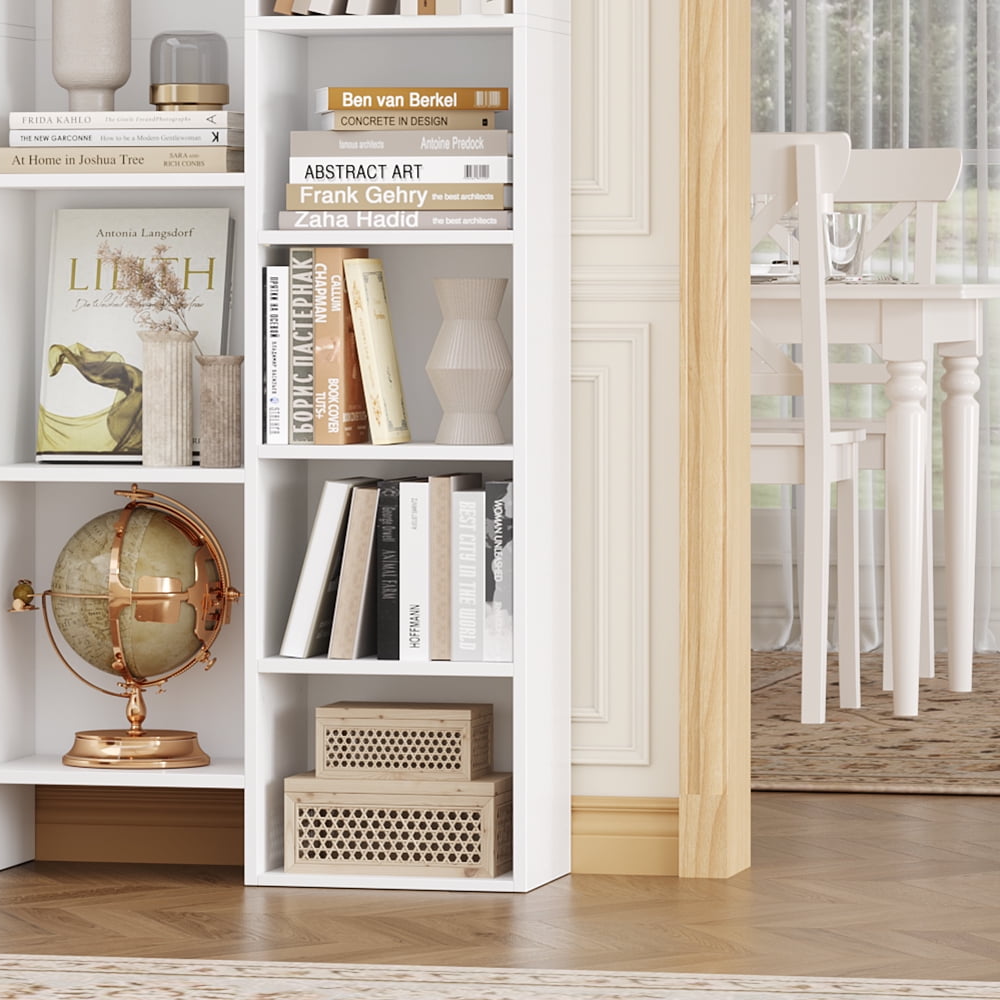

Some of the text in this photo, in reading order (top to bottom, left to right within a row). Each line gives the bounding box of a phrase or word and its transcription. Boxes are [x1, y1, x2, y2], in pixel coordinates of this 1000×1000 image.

[342, 92, 457, 107] Ben van Berkel
[22, 116, 92, 125] FRIDA KAHLO
[340, 116, 448, 126] CONCRETE IN DESIGN
[420, 136, 485, 150] Antoine Predock
[11, 154, 145, 167] At Home in Joshua Tree
[304, 164, 423, 179] ABSTRACT ART
[300, 186, 428, 207] Frank Gehry
[431, 193, 494, 201] the best architects
[294, 211, 419, 228] Zaha Hadid
[432, 217, 498, 225] the best architects
[96, 228, 195, 240] Antonia Langsdorf
[315, 263, 327, 323] CHAPMAN
[330, 274, 341, 312] CALLUM
[292, 251, 315, 434] БОРИС ПАСТЕРНАК
[315, 392, 326, 419] TUTS+
[328, 378, 339, 433] BOOK COVER
[493, 500, 504, 582] WOMAN UNLEASHED
[382, 549, 398, 600] ANIMAL FARM
[459, 500, 477, 650] BEST CITY THE WORLD
[410, 604, 420, 649] HOFFMANN
